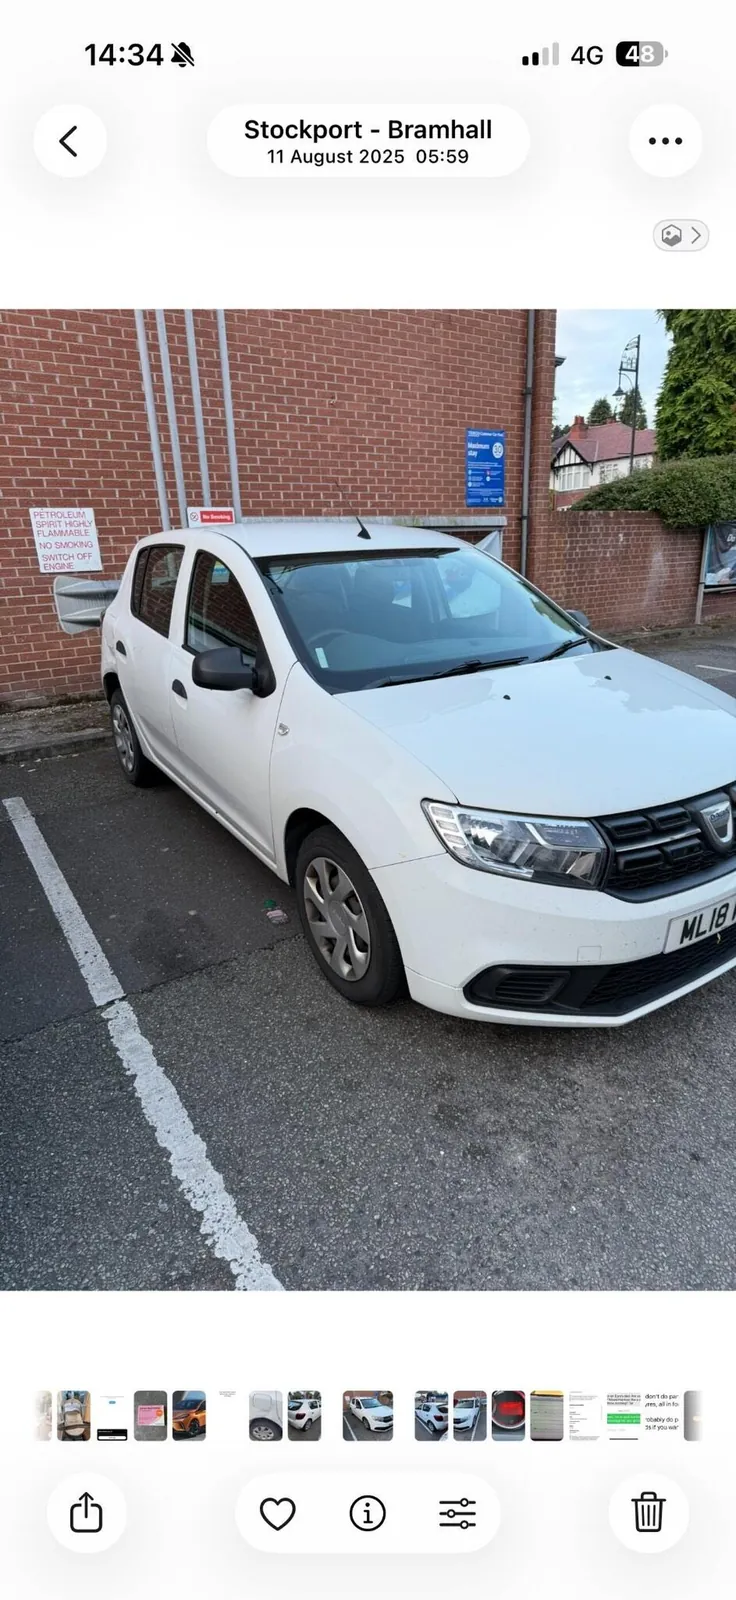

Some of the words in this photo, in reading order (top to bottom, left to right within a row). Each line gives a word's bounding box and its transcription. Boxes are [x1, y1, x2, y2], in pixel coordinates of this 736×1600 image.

[33, 511, 86, 519] PETROLEUM
[35, 520, 62, 528] SPIRIT
[64, 520, 93, 528] HIGHLY
[36, 529, 90, 538] FLAMMABLE
[39, 541, 53, 550] NO
[54, 540, 94, 549] SMOKING
[41, 553, 75, 562] SWITCH
[76, 552, 93, 560] OFF
[43, 562, 75, 571] ENGINE
